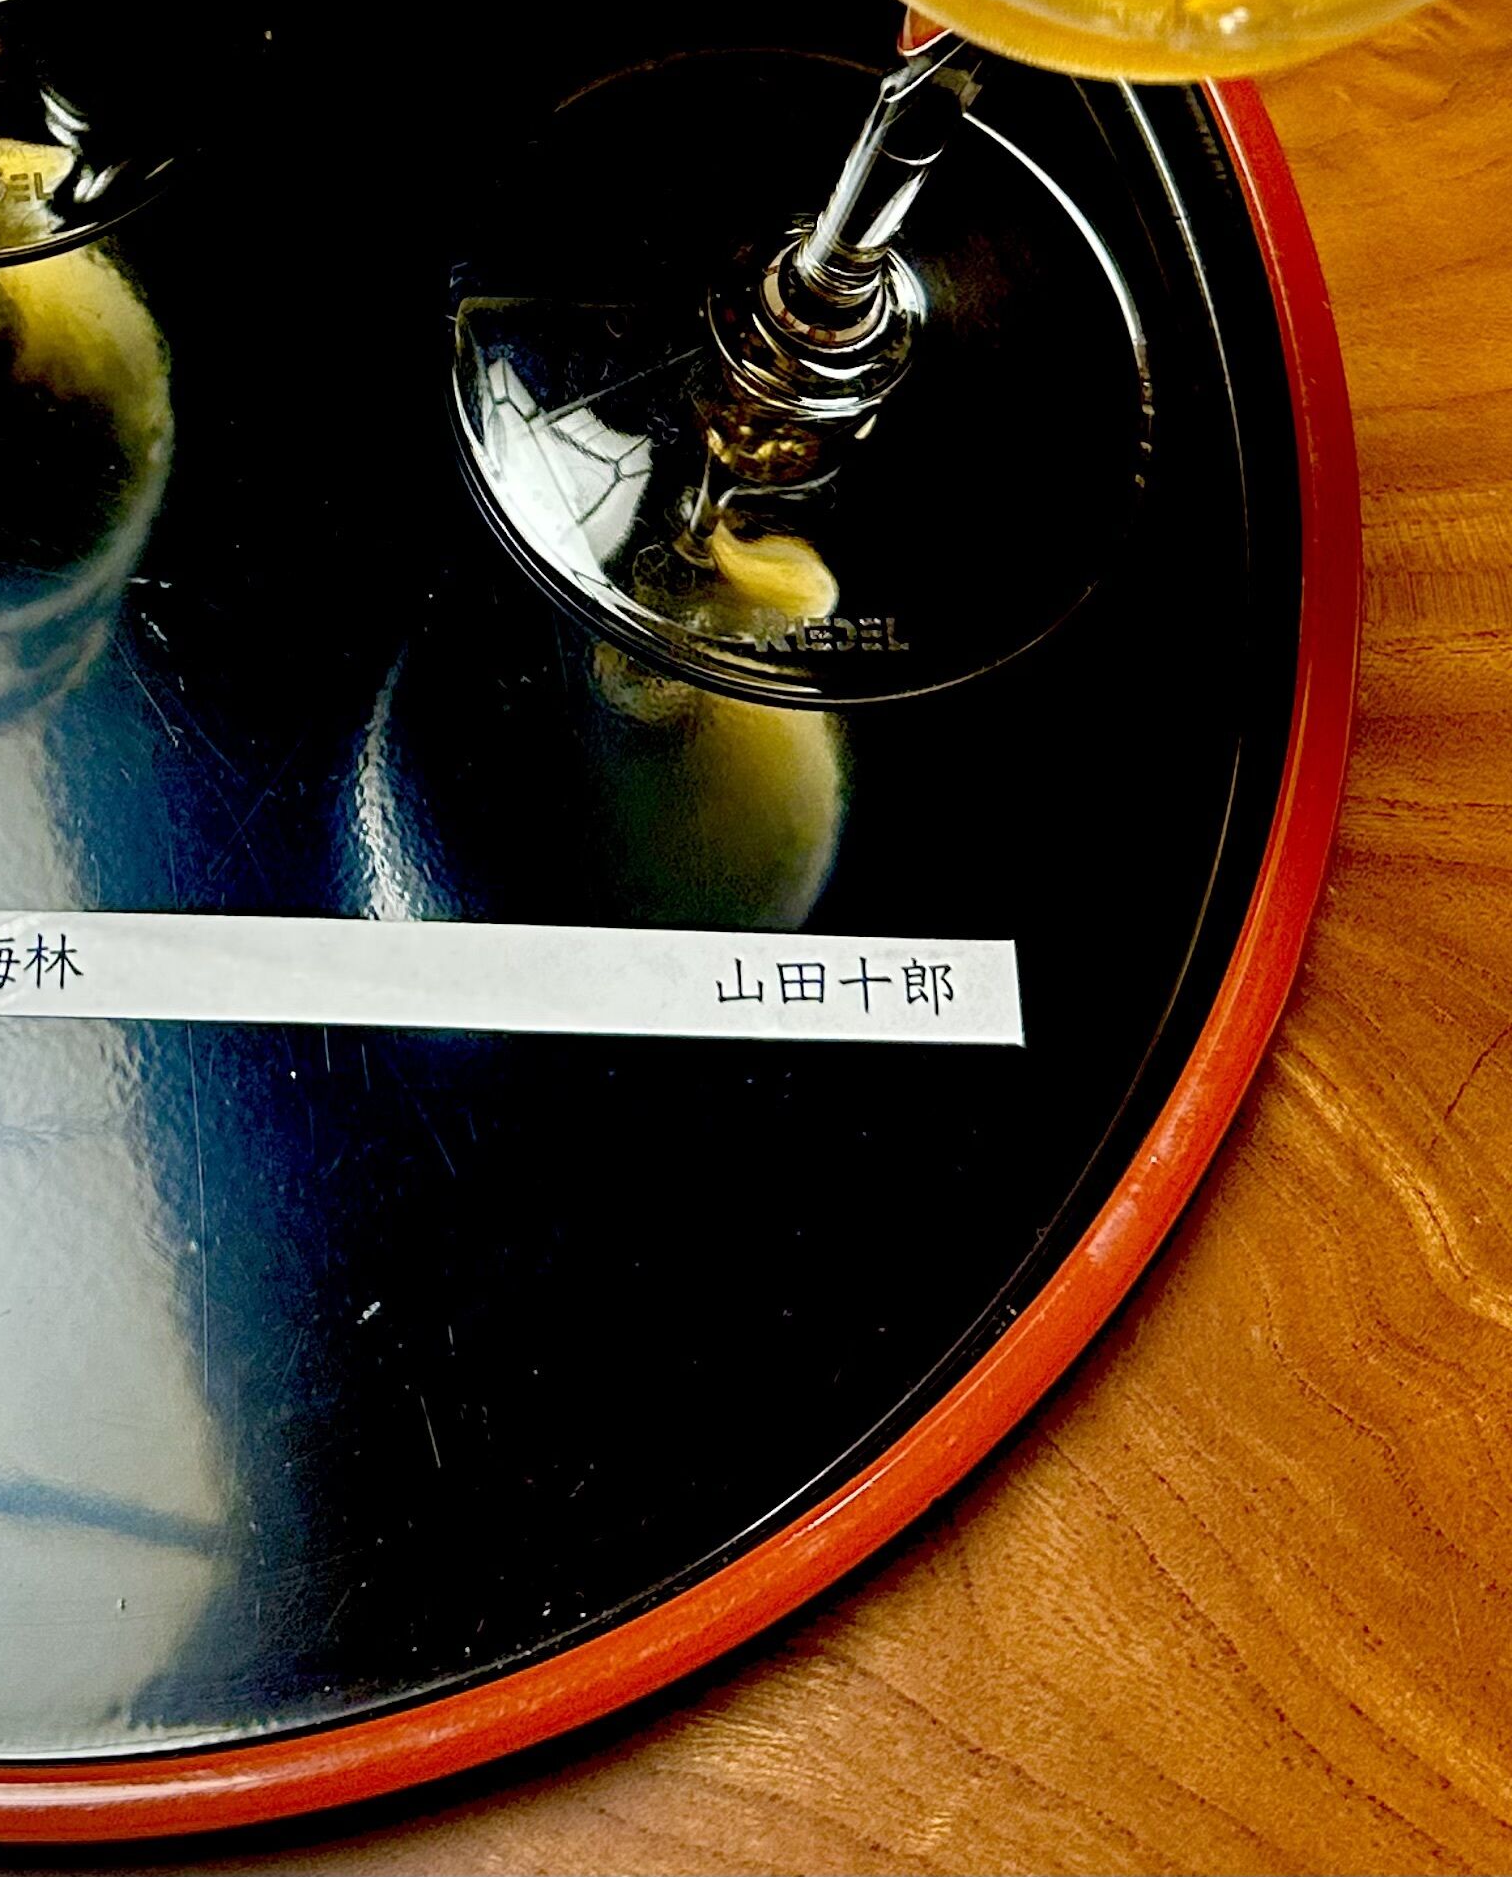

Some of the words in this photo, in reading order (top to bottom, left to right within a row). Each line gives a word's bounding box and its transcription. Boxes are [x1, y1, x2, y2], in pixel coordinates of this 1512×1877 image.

[751, 609, 910, 652] RIEDEL
[716, 957, 954, 1016] 山田十郎
